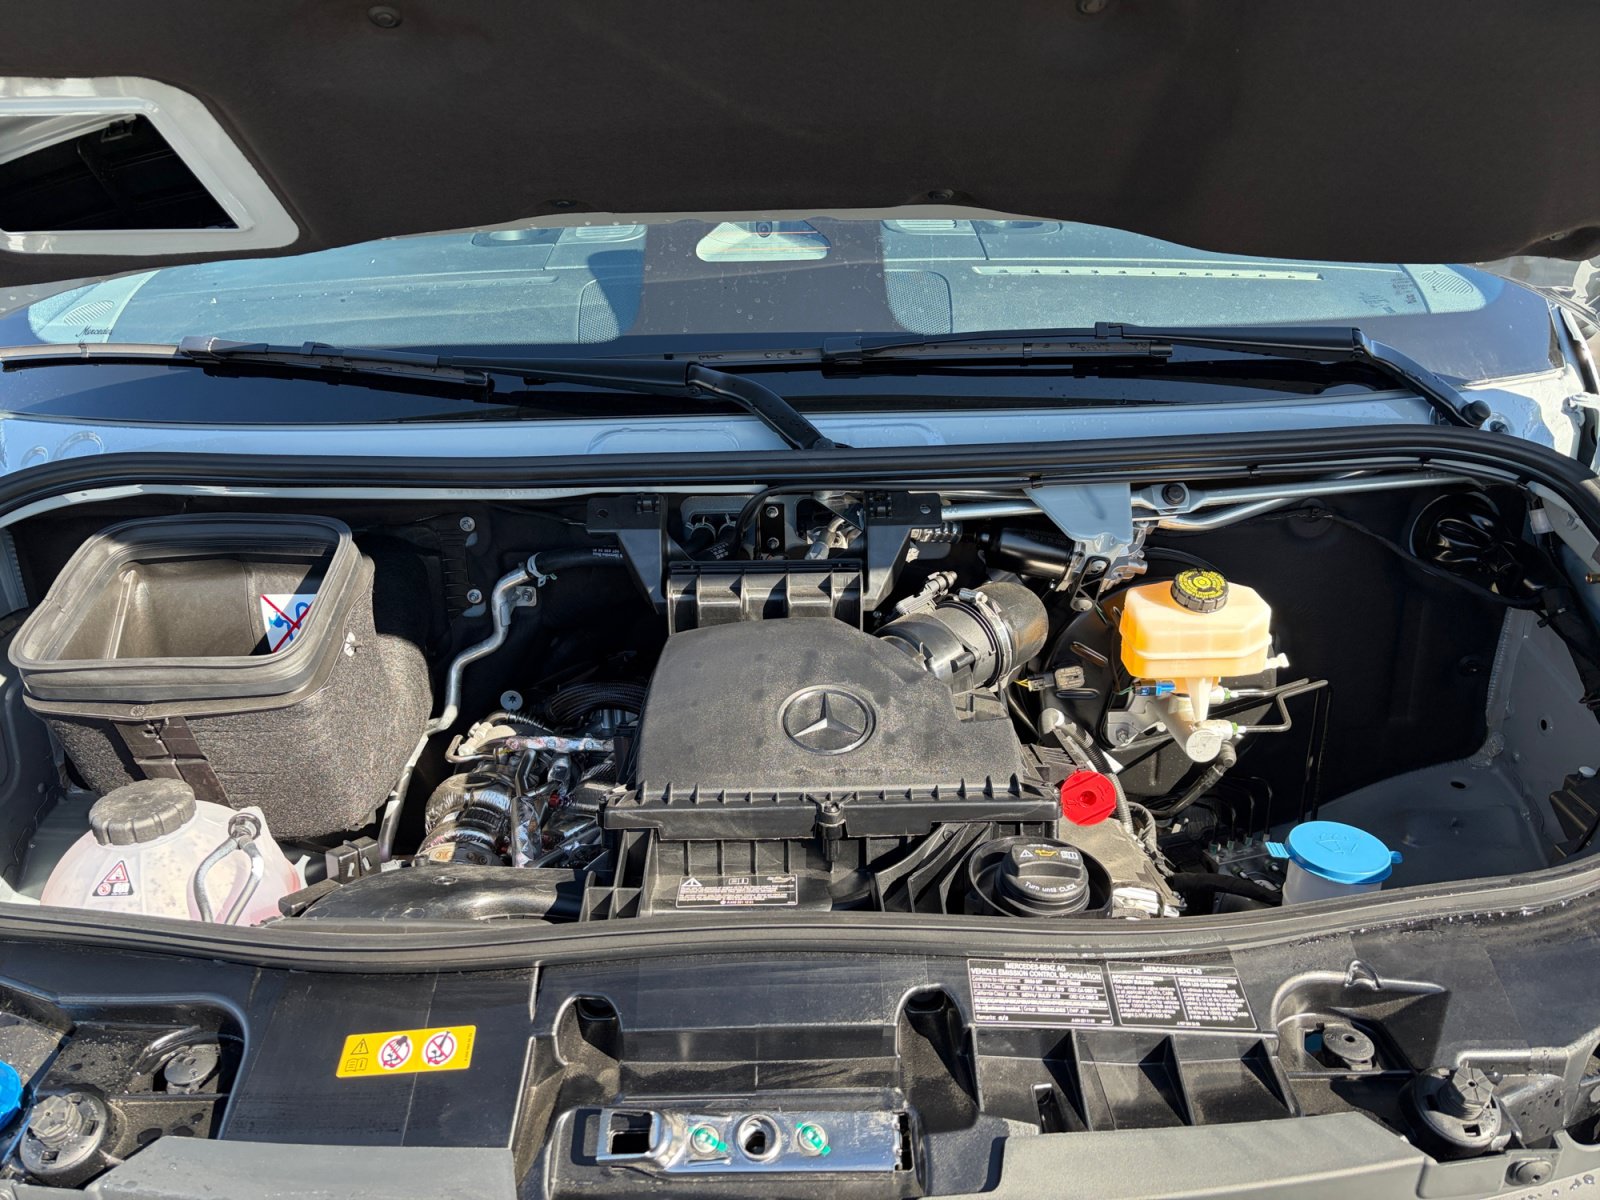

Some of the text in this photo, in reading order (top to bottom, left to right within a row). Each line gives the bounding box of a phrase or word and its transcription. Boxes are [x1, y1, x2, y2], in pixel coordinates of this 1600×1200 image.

[1024, 881, 1040, 891] Turn
[1058, 882, 1077, 892] CLICK
[1004, 963, 1056, 971] MERCEDES-BENZ
[998, 969, 1028, 977] EMISSION
[1029, 970, 1059, 978] CONTROL
[1059, 971, 1101, 980] INFORMATION
